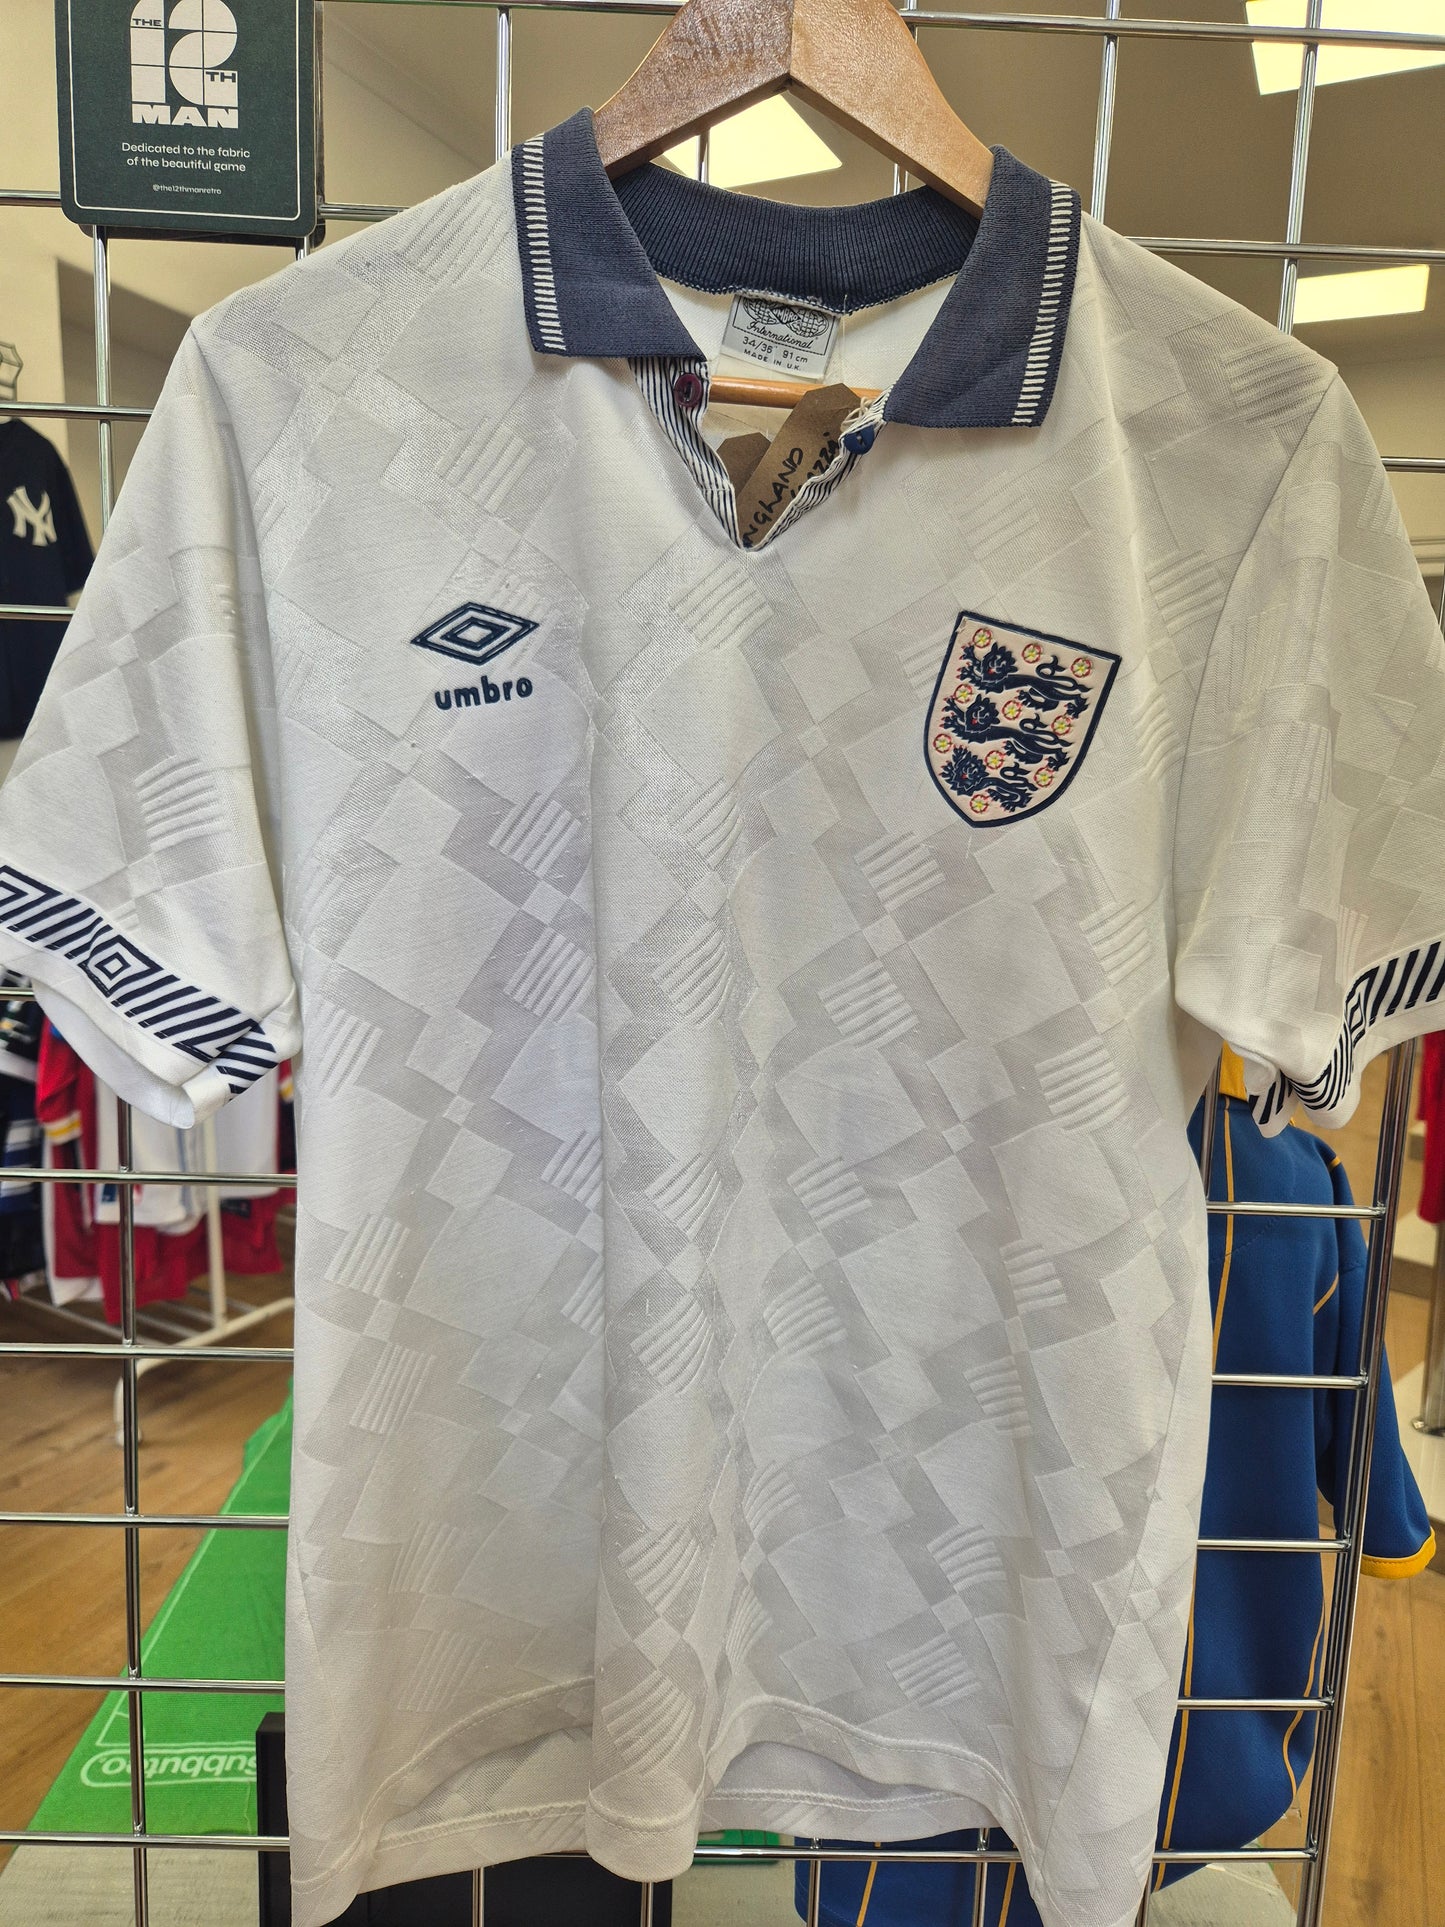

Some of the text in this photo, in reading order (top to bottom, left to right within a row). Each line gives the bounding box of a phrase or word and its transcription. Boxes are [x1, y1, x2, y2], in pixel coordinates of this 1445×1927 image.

[132, 18, 162, 27] THE
[205, 71, 237, 83] TH
[131, 104, 239, 129] MAN
[121, 142, 250, 158] Dedicated to the fabric
[126, 156, 246, 173] of the beautiful game
[152, 183, 222, 195] @the12thmanretro
[746, 321, 814, 350] International
[743, 348, 769, 363] MADE
[773, 359, 782, 367] IN
[742, 447, 804, 548] NGLAND
[6, 485, 57, 547] NY
[434, 675, 533, 711] umbro
[101, 1753, 256, 1779] Subbuto
